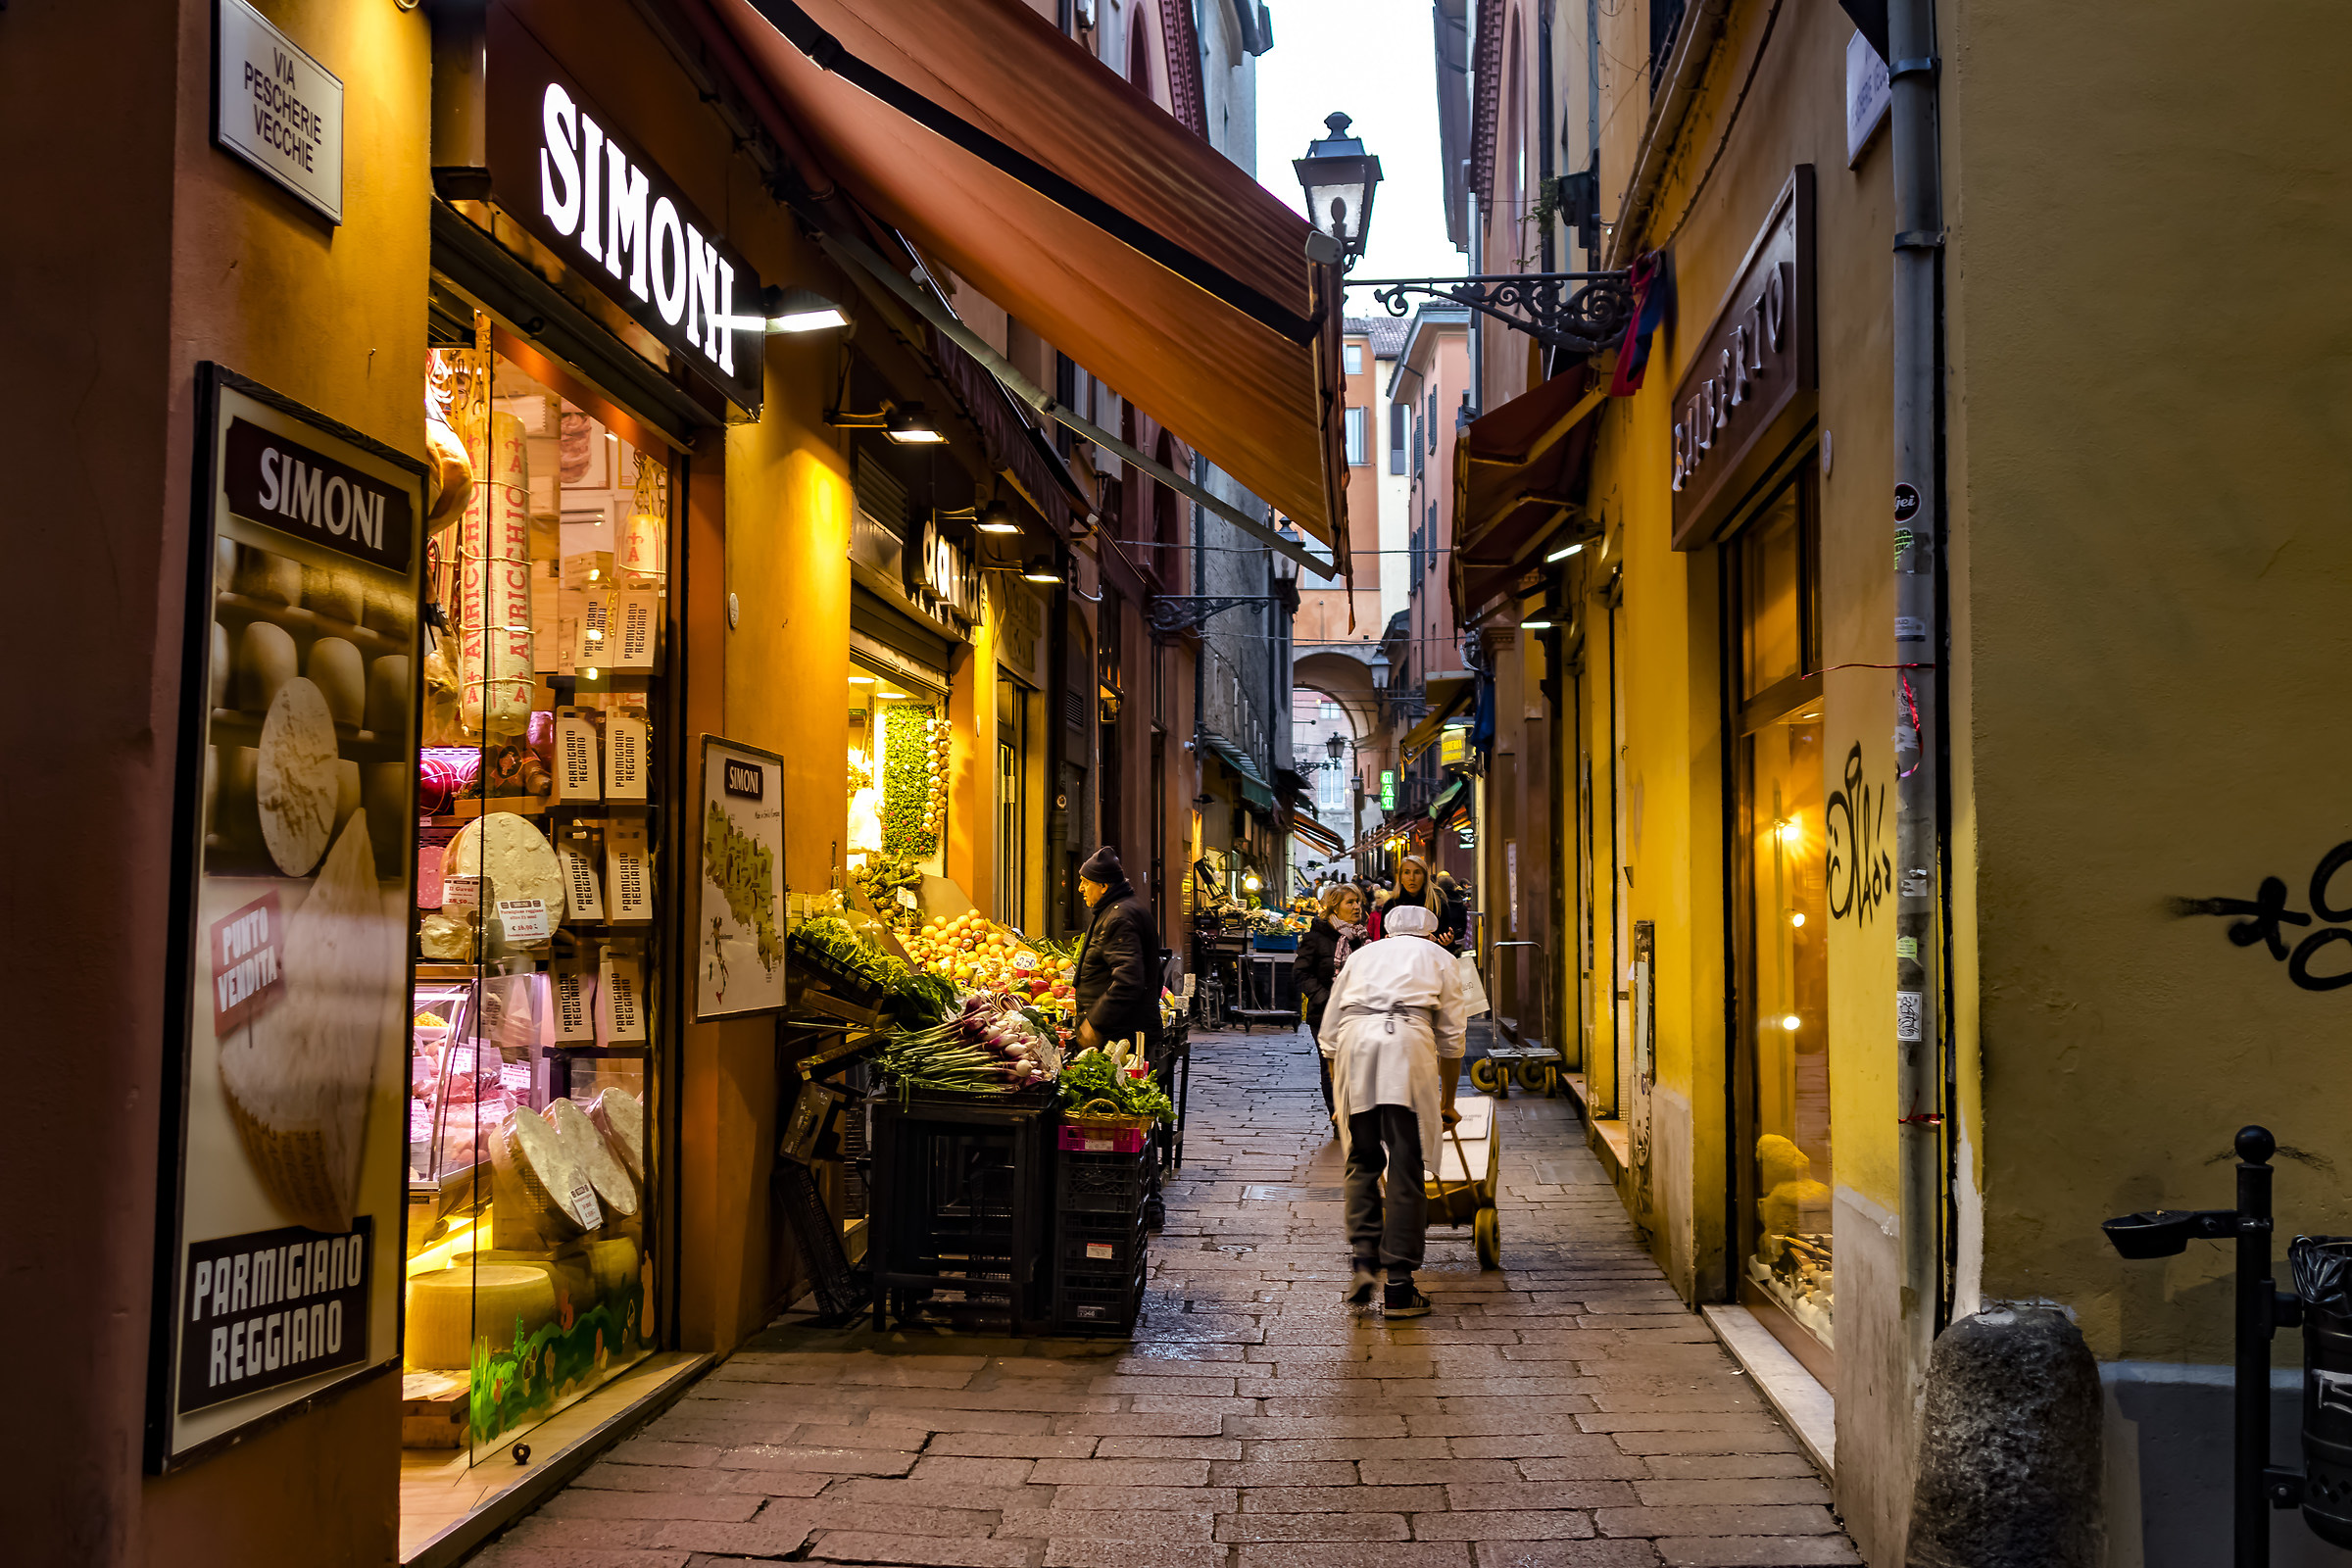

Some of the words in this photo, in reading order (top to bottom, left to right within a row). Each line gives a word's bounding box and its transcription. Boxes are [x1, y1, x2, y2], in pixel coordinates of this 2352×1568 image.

[273, 47, 296, 90] VIA
[244, 60, 321, 145] PESCHERIE
[253, 103, 314, 173] VECCHIE
[540, 82, 734, 377] SIMONI
[259, 446, 384, 551] SIMONI
[505, 484, 530, 662] AURICCHIO
[584, 601, 598, 658] PARIGIANO
[594, 608, 607, 652] REGIANO
[624, 603, 638, 660] PARMIGIANO
[635, 609, 647, 654] REGGIANO
[566, 730, 578, 788] PARMIGIANO
[577, 737, 588, 781] REGGIANO
[615, 730, 624, 787] PARMIGIANO
[729, 765, 759, 794] SIMONI
[570, 853, 586, 911] PARMIGIANO
[579, 858, 594, 905] REGGIANO
[619, 853, 632, 911] PARMIGIANO
[630, 858, 641, 905] REGGIANO
[222, 906, 269, 966] PUNTO
[218, 945, 278, 1013] VENDITA
[560, 973, 573, 1033] PARMIGIANO
[570, 979, 582, 1026] REGGIANO
[612, 973, 626, 1033] PARMIGIANO
[621, 979, 635, 1026] REGGIANO
[192, 1234, 363, 1322] PARMIGIANO
[210, 1299, 342, 1388] REGGIANO
